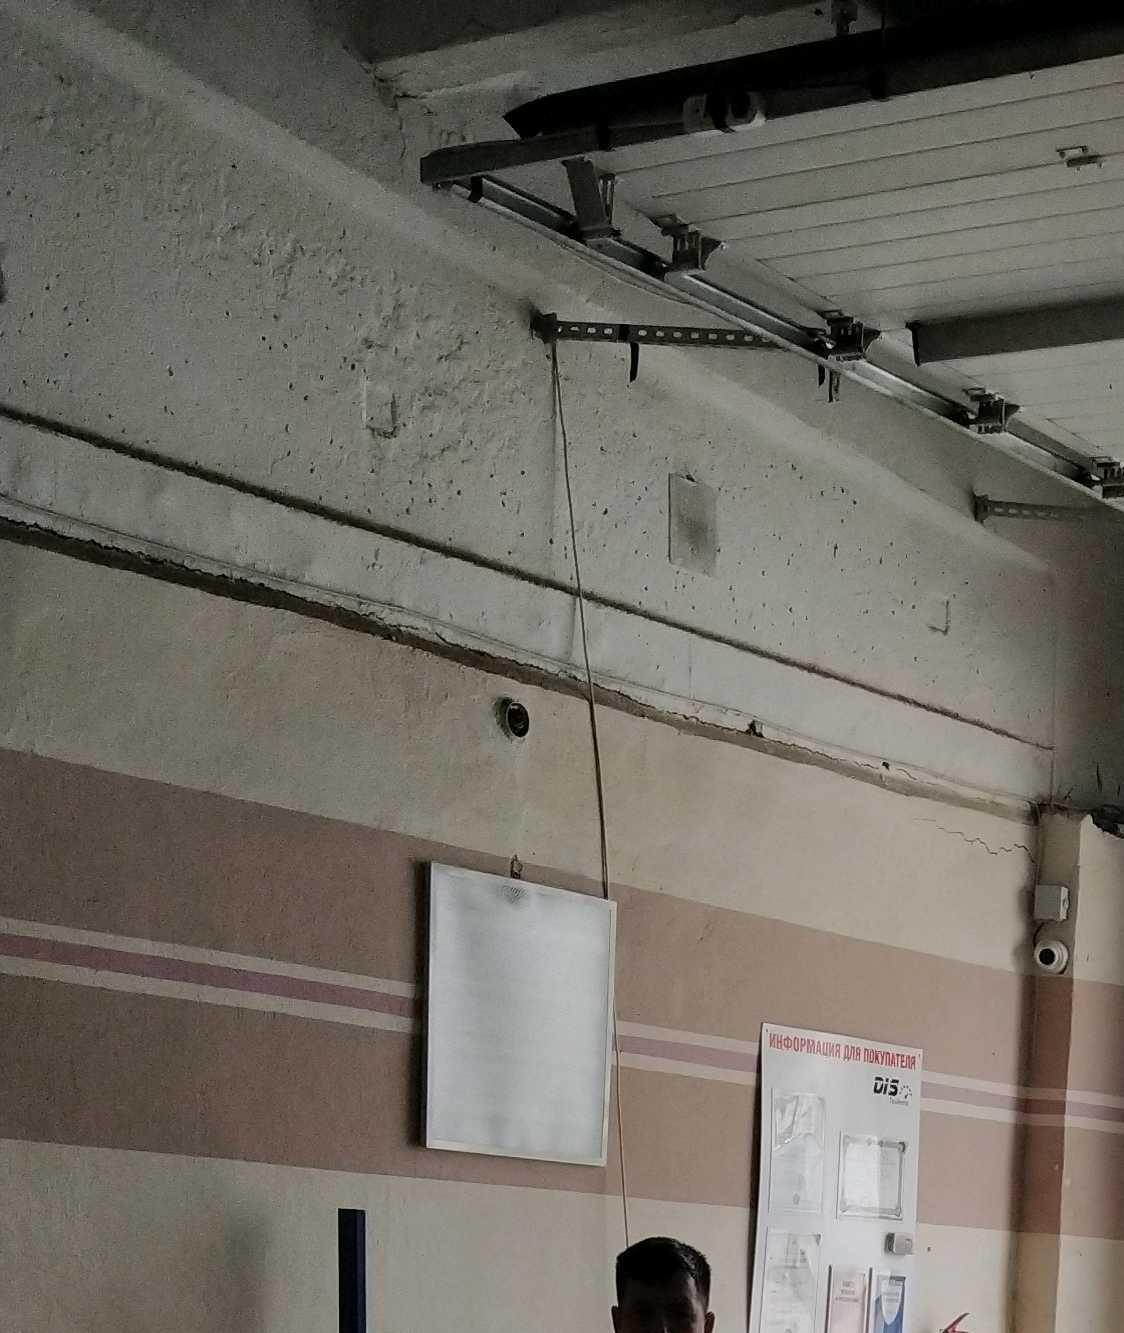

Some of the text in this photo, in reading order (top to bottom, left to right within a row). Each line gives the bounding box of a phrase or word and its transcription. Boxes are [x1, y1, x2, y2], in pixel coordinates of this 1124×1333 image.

[769, 1032, 917, 1070] ИНФОРМАЦИЯ ДЛЯ ПОКУПАТЕЛЯ
